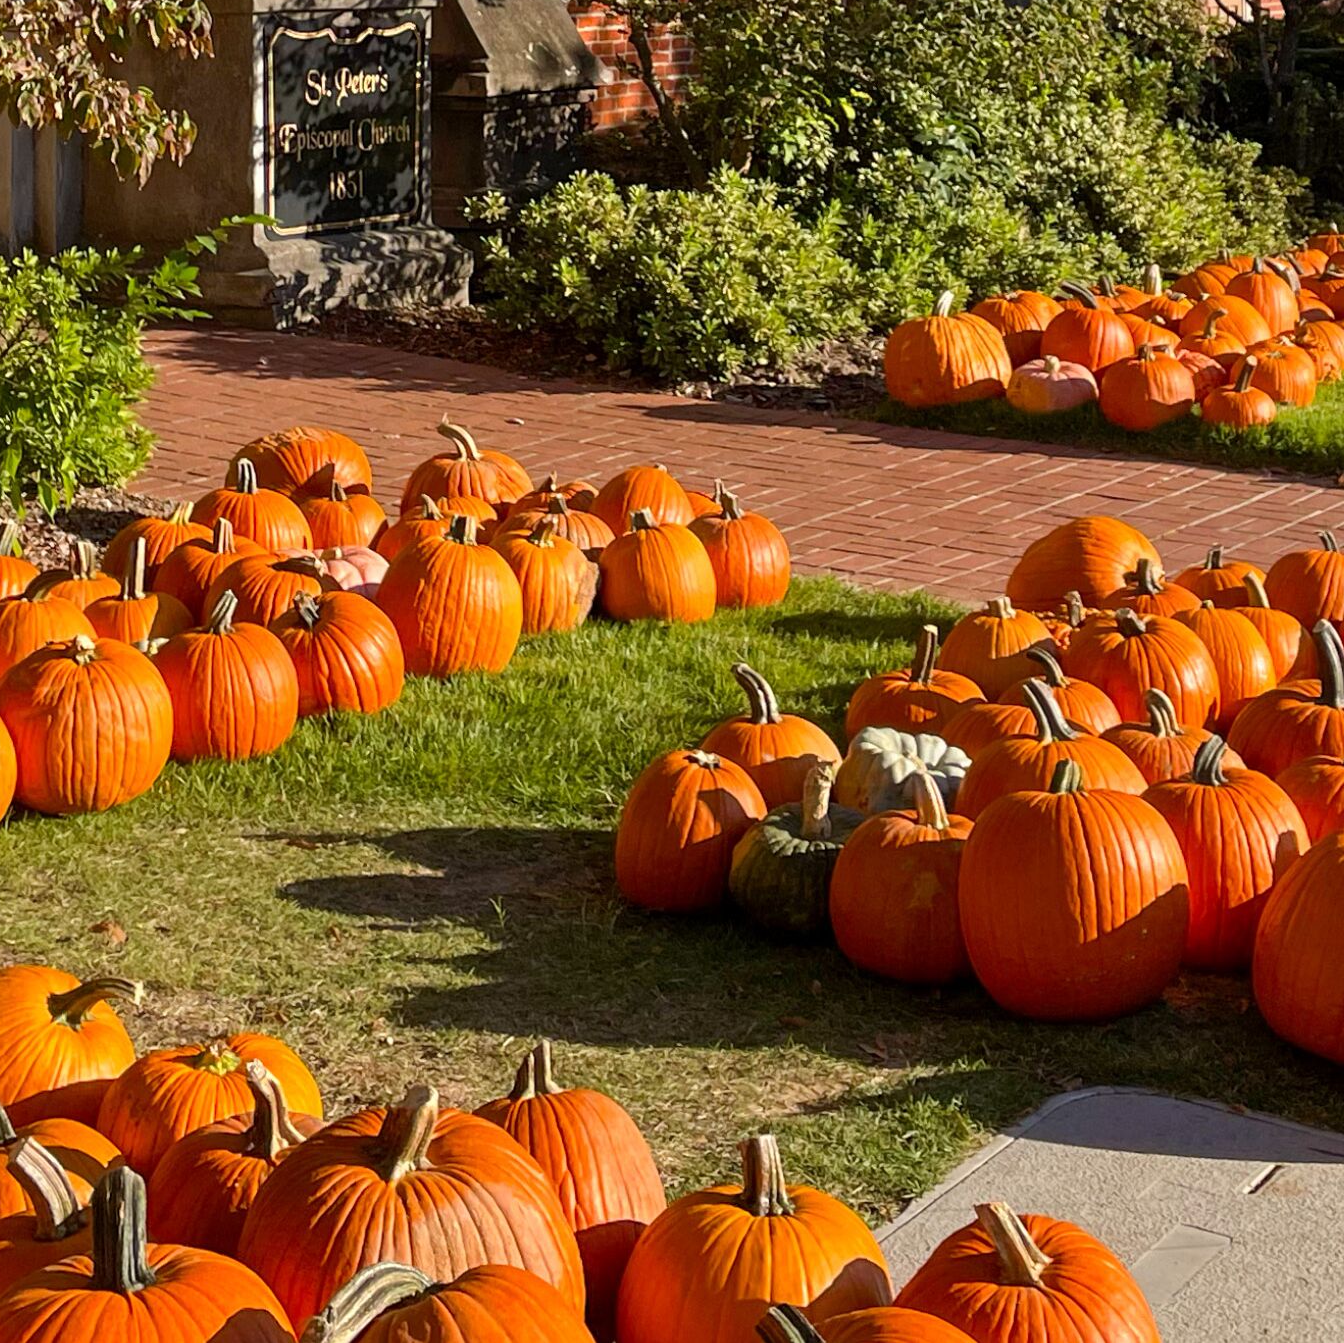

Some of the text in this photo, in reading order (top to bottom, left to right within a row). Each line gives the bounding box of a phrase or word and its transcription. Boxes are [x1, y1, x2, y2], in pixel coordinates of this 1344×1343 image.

[305, 66, 389, 107] St. Peter's
[279, 116, 410, 161] Episcopal Church
[329, 170, 364, 201] 1851
